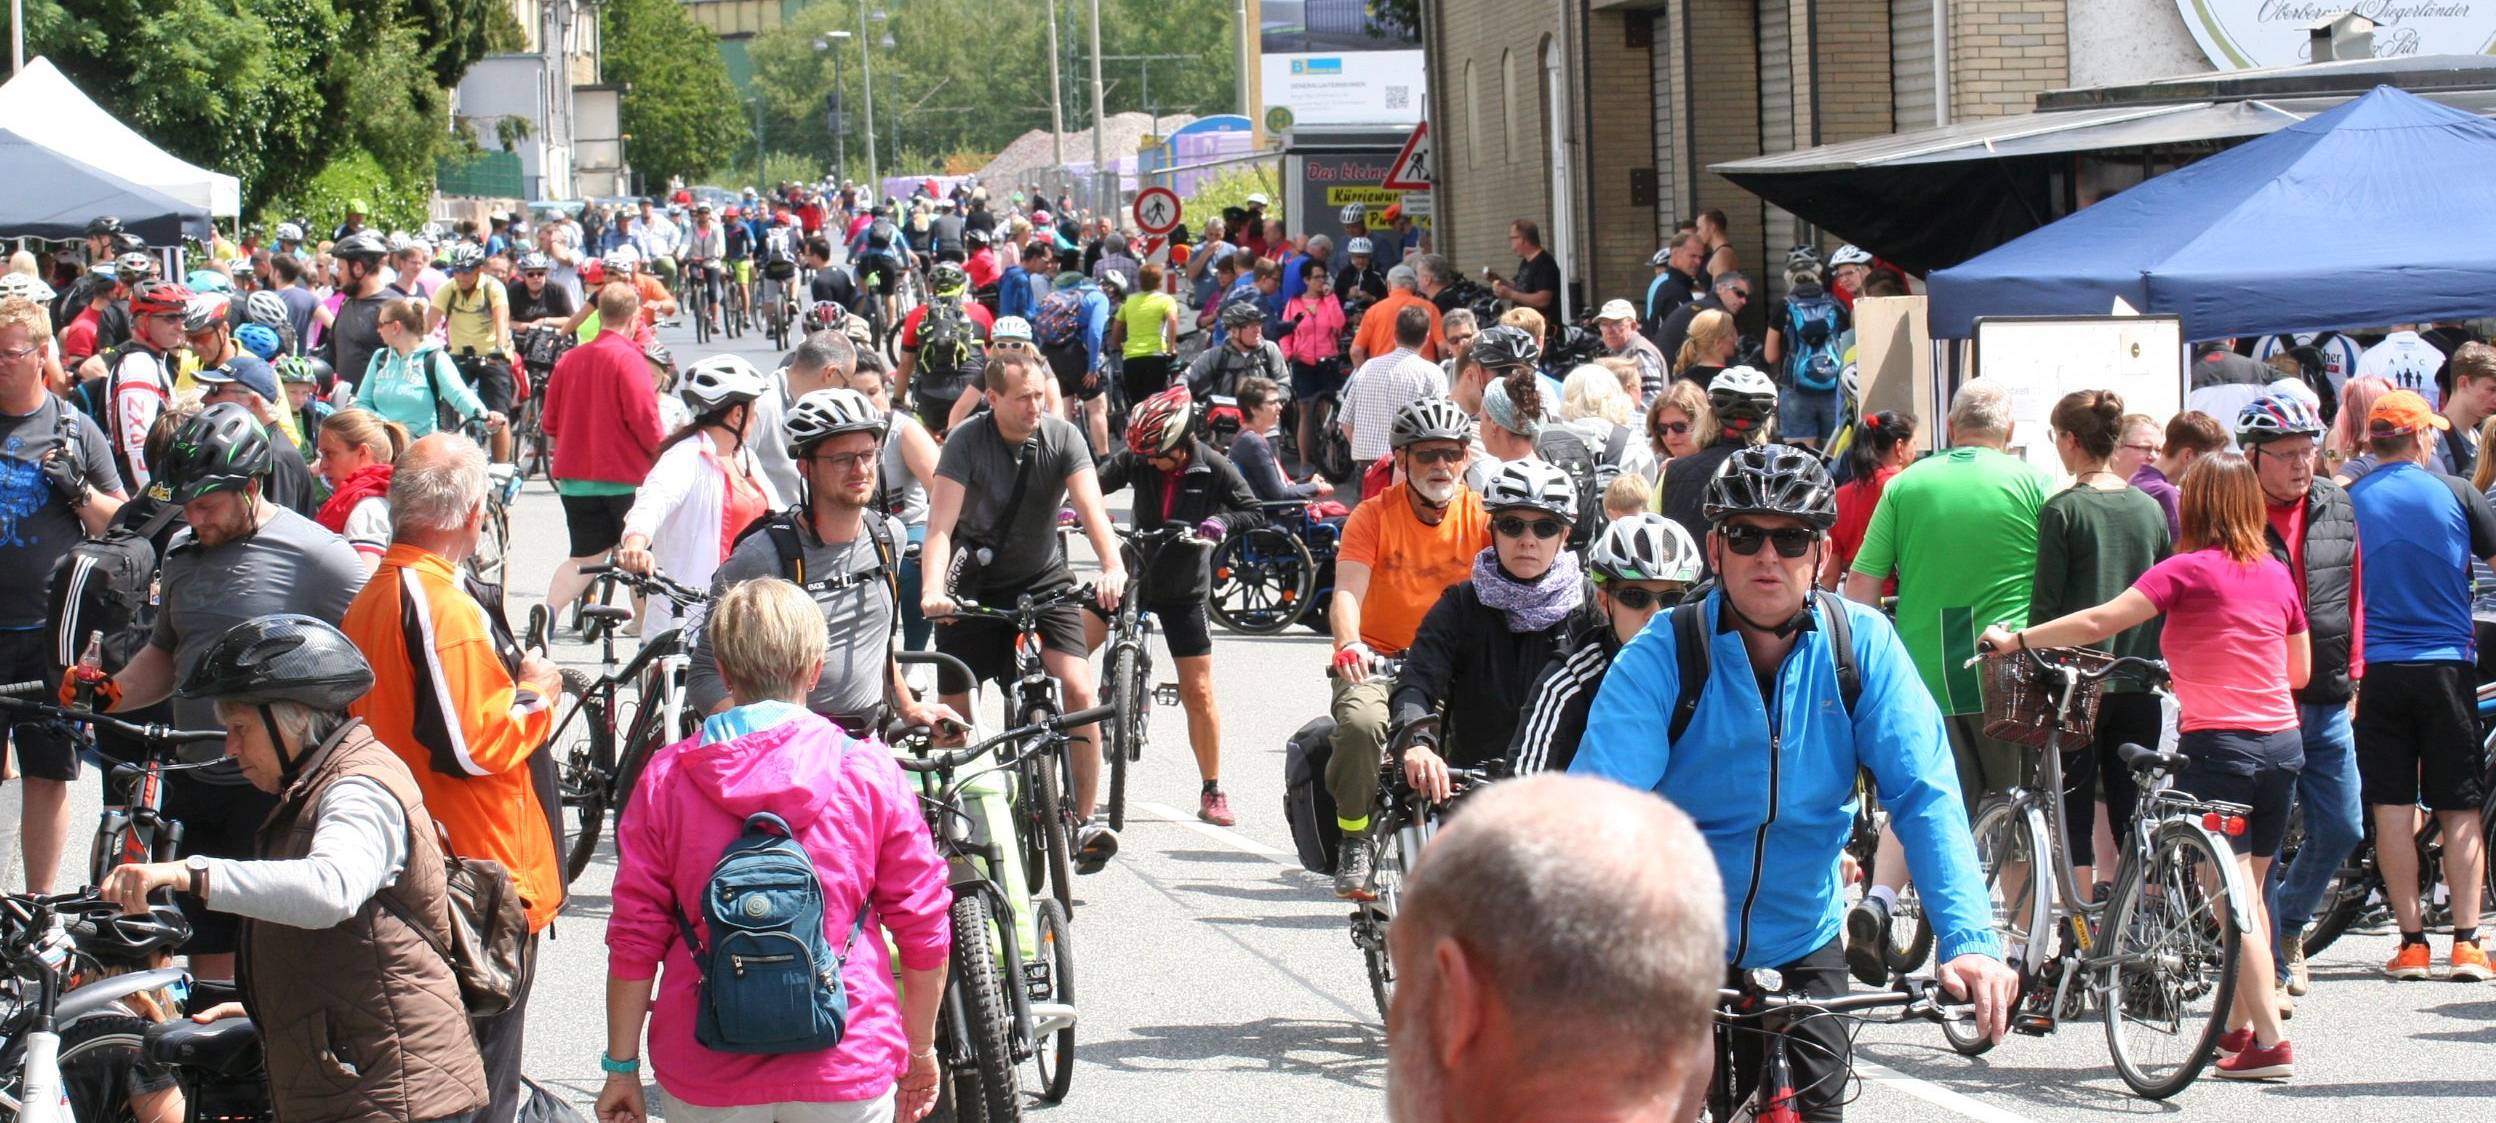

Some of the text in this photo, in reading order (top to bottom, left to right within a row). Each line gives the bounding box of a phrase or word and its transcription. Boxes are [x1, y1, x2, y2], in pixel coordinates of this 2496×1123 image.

[1307, 161, 1336, 180] Das
[1334, 189, 1400, 203] Kürriewur
[946, 555, 965, 594] adidas
